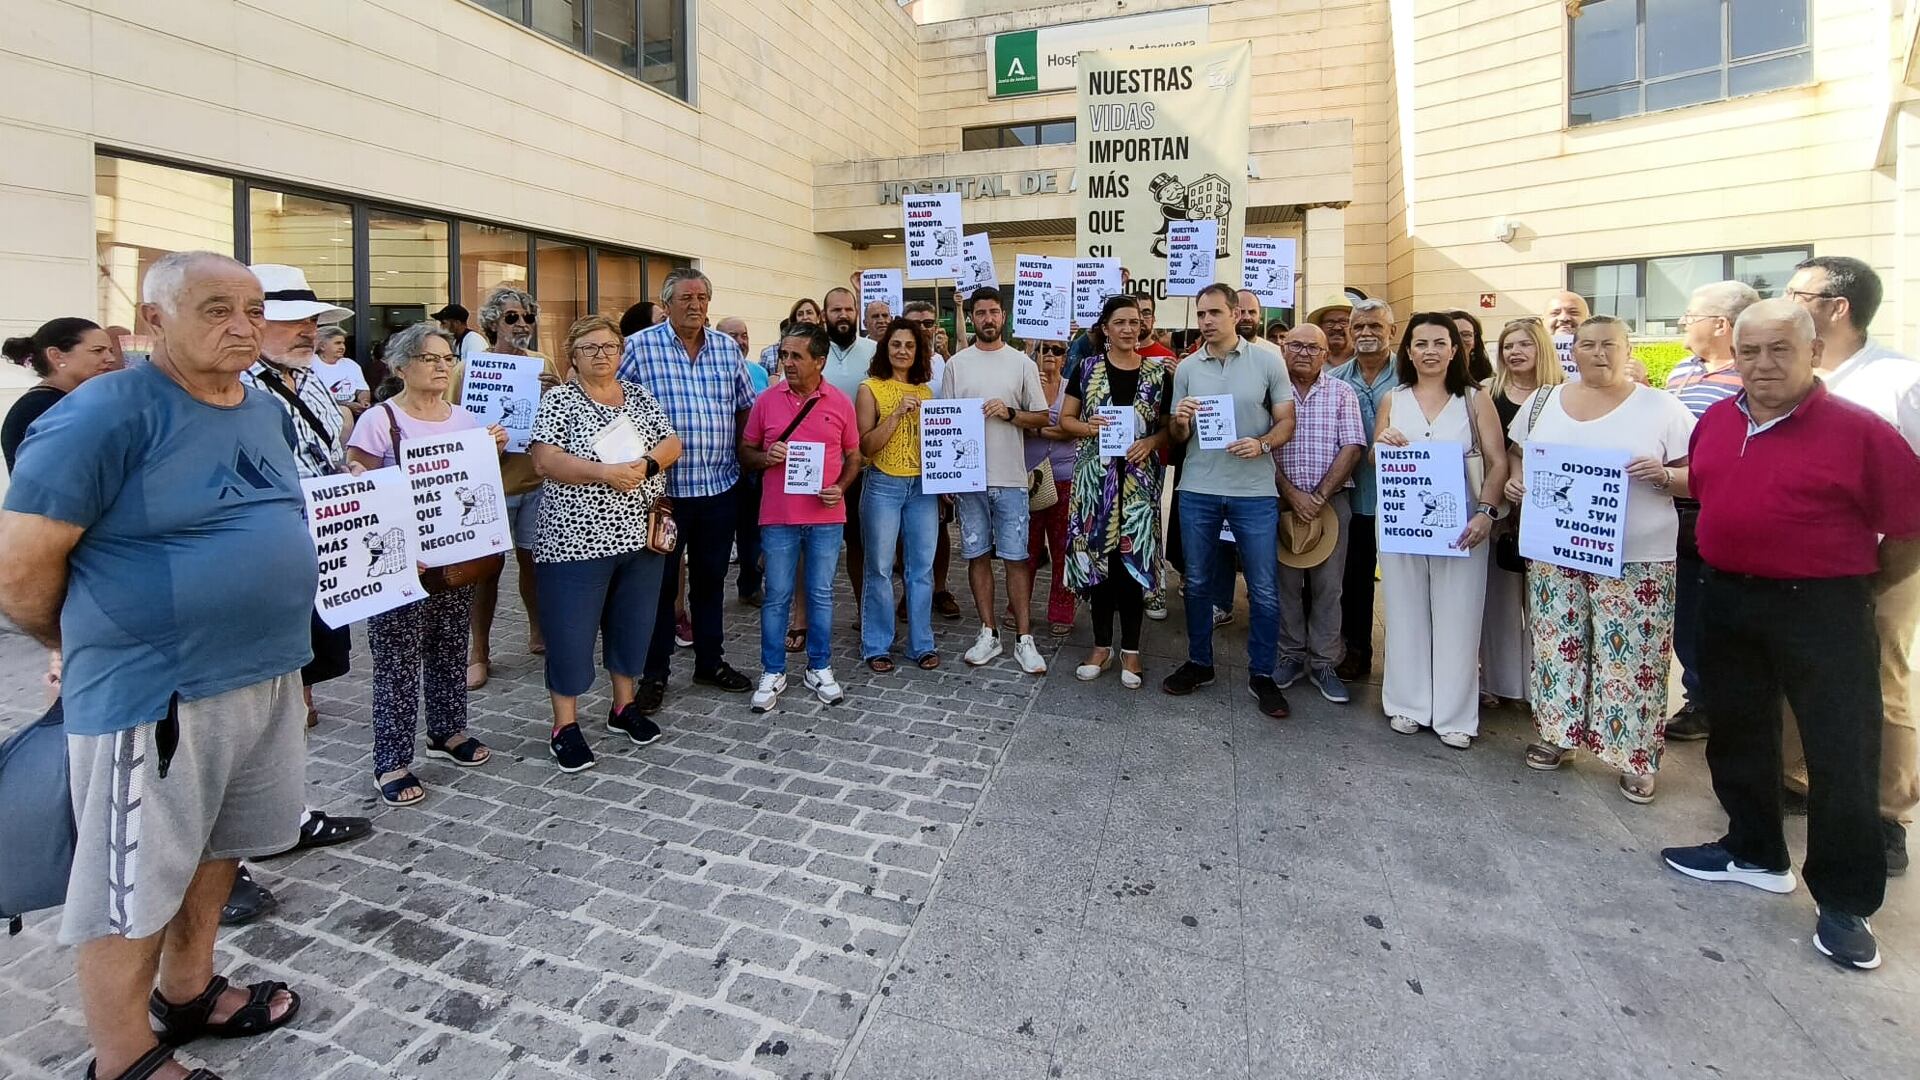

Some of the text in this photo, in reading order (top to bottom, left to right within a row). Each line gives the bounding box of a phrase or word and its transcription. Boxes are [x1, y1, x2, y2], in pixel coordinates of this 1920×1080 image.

[1089, 66, 1192, 95] NUESTRAS
[1089, 102, 1155, 132] VIDAS
[1089, 136, 1189, 163] IMPORTAN
[1020, 170, 1057, 195] DE
[1089, 170, 1129, 198] MÁS
[1089, 210, 1125, 234] QUE
[910, 240, 924, 248] QUE
[1020, 262, 1052, 270] NUESTRA
[1018, 299, 1032, 307] QUE
[1017, 318, 1048, 326] NEGOCIO
[472, 360, 516, 370] NUESTRA
[470, 371, 502, 380] SALUD
[468, 382, 513, 392] IMPORTA
[466, 405, 486, 413] QUE
[925, 406, 961, 414] NUESTRA
[925, 428, 962, 436] IMPORTA
[407, 441, 464, 459] NUESTRA
[926, 450, 942, 458] QUE
[1381, 451, 1430, 459] NUESTRA
[408, 459, 450, 475] SALUD
[1381, 464, 1416, 472] SALUD
[1561, 462, 1622, 479] NEGOCIO
[411, 471, 469, 490] IMPORTA
[926, 471, 962, 480] NEGOCIO
[1382, 476, 1432, 485] IMPORTA
[312, 480, 376, 502] NUESTRA
[1383, 487, 1406, 498] MÁS
[1603, 482, 1620, 493] SU
[413, 490, 441, 505] MÁS
[1591, 495, 1618, 508] QUE
[315, 500, 360, 520] SALUD
[416, 506, 442, 521] QUE
[1383, 502, 1405, 511] QUE
[317, 513, 379, 538] IMPORTA
[1384, 515, 1397, 523] SU
[418, 523, 434, 536] SU
[1385, 527, 1432, 537] NEGOCIO
[1555, 518, 1615, 538] IMPORTA
[317, 537, 348, 556] MÁS
[420, 530, 475, 551] NEGOCIO
[1570, 535, 1614, 552] SALUD
[1552, 545, 1613, 567] NUESTRA
[318, 556, 347, 575] QUE
[320, 577, 338, 592] SU
[322, 581, 383, 609] NEGOCIO
